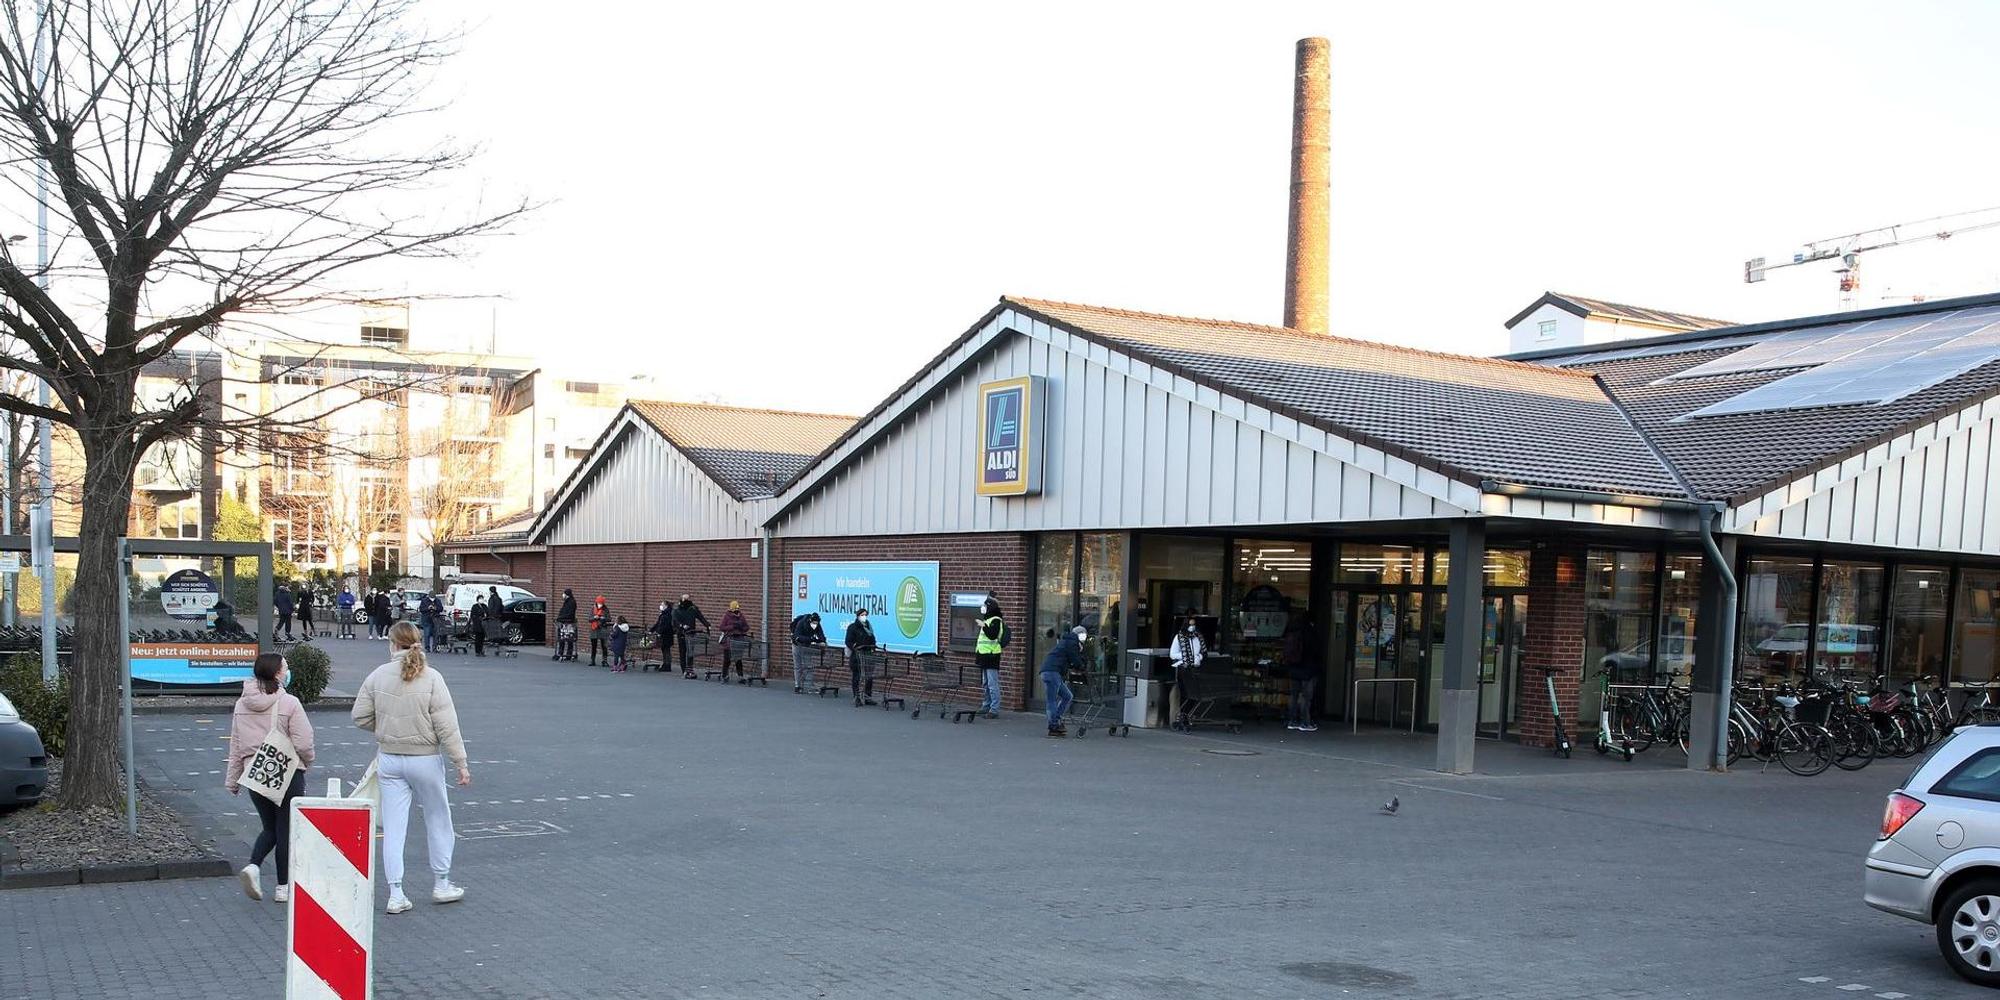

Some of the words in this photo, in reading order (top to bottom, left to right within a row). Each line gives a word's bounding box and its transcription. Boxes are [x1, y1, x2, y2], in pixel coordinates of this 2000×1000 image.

[987, 450, 1017, 470] ALDI
[1005, 468, 1016, 480] SÜD
[819, 592, 889, 616] KLIMANEUTRAL
[131, 647, 154, 656] Neu:
[155, 647, 178, 656] Jetzt
[180, 646, 210, 656] online
[212, 647, 256, 656] bezahlen
[253, 753, 287, 782] BOX
